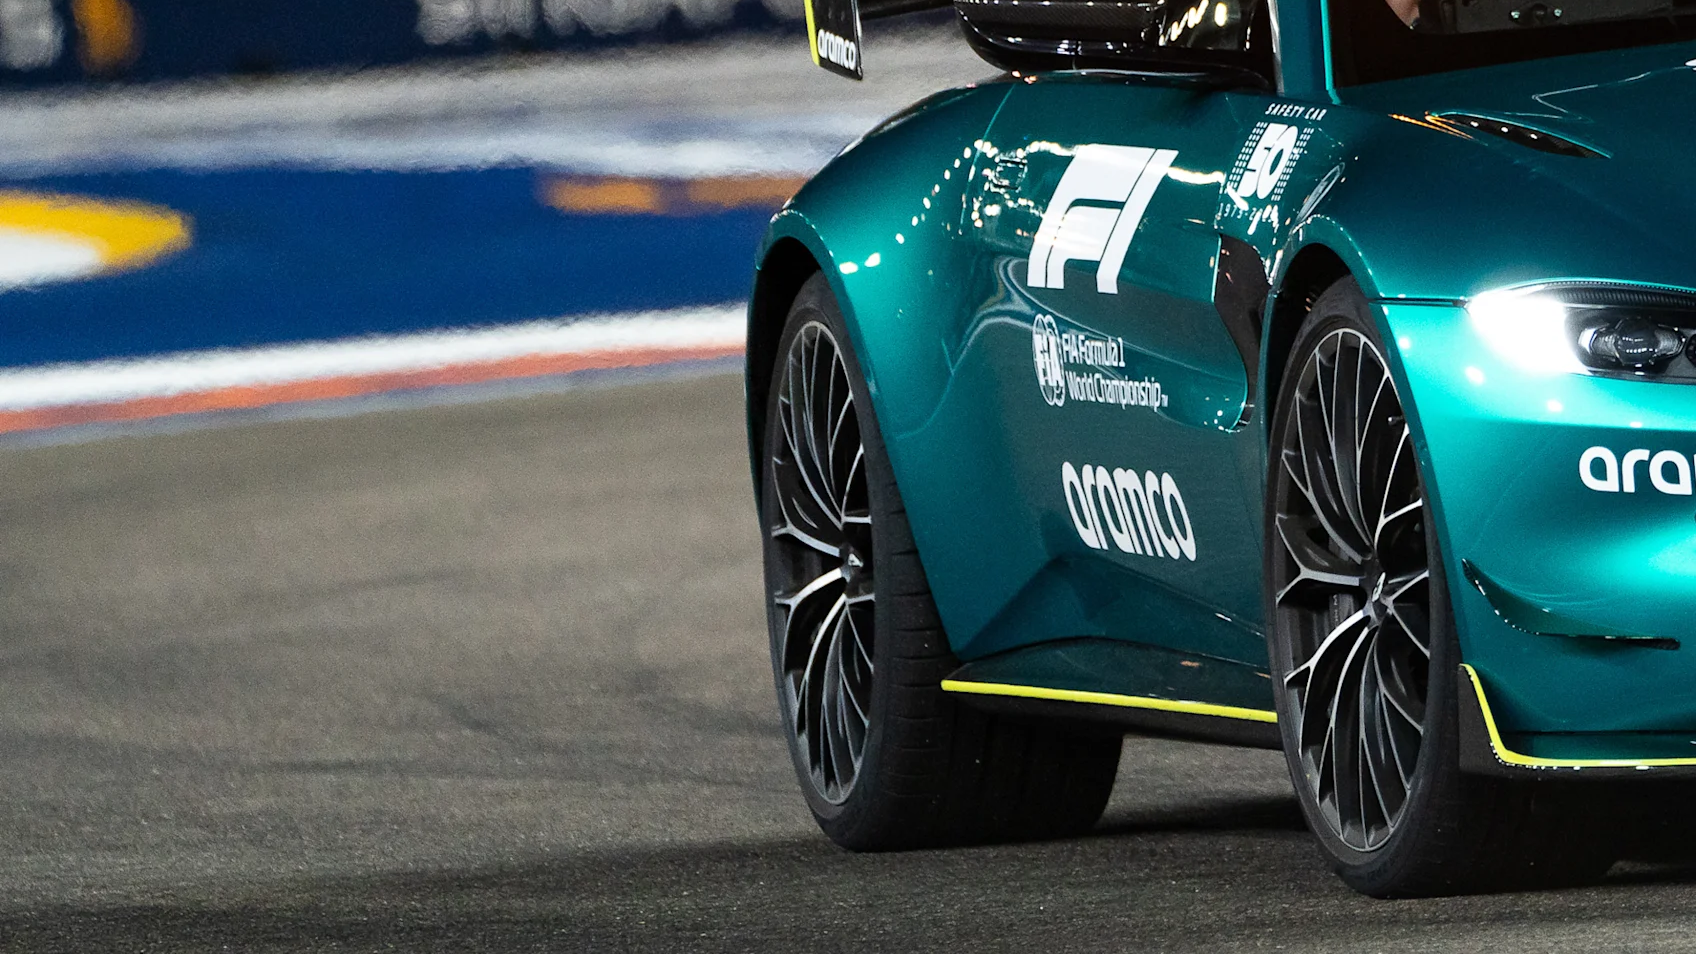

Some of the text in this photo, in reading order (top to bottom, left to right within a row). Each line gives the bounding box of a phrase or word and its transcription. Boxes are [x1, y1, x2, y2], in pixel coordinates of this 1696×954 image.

[817, 28, 856, 71] aramco
[1264, 102, 1328, 121] SAFETY CAR
[1237, 123, 1298, 199] 50
[1061, 332, 1126, 368] FIA Formula 1
[1064, 369, 1097, 403] World
[1093, 372, 1162, 413] Championship
[1061, 461, 1197, 562] aramco
